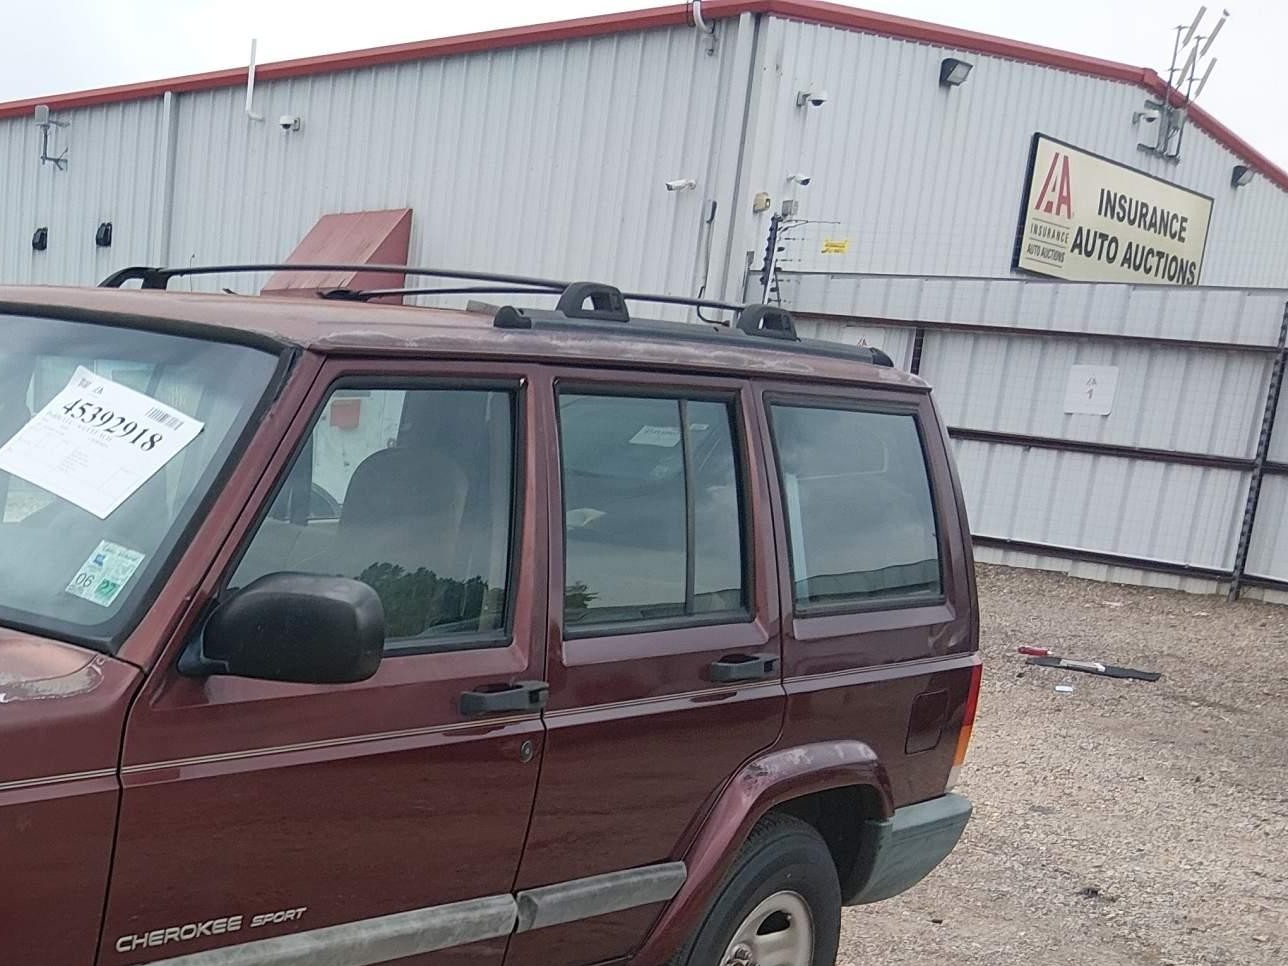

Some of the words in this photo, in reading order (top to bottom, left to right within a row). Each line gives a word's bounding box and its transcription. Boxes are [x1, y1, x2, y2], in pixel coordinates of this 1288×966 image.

[1030, 223, 1070, 244] INSURANCE
[1097, 187, 1189, 243] INSURANCE
[1026, 243, 1042, 257] AUTO
[1040, 247, 1066, 263] AUCTIONS
[1070, 226, 1119, 264] AUTO
[1120, 241, 1197, 285] AUCTIONS
[62, 398, 164, 452] 45392918
[75, 572, 96, 588] 06
[98, 579, 119, 594] 27
[115, 915, 244, 953] CHEROKEE
[250, 906, 308, 928] SPORT
